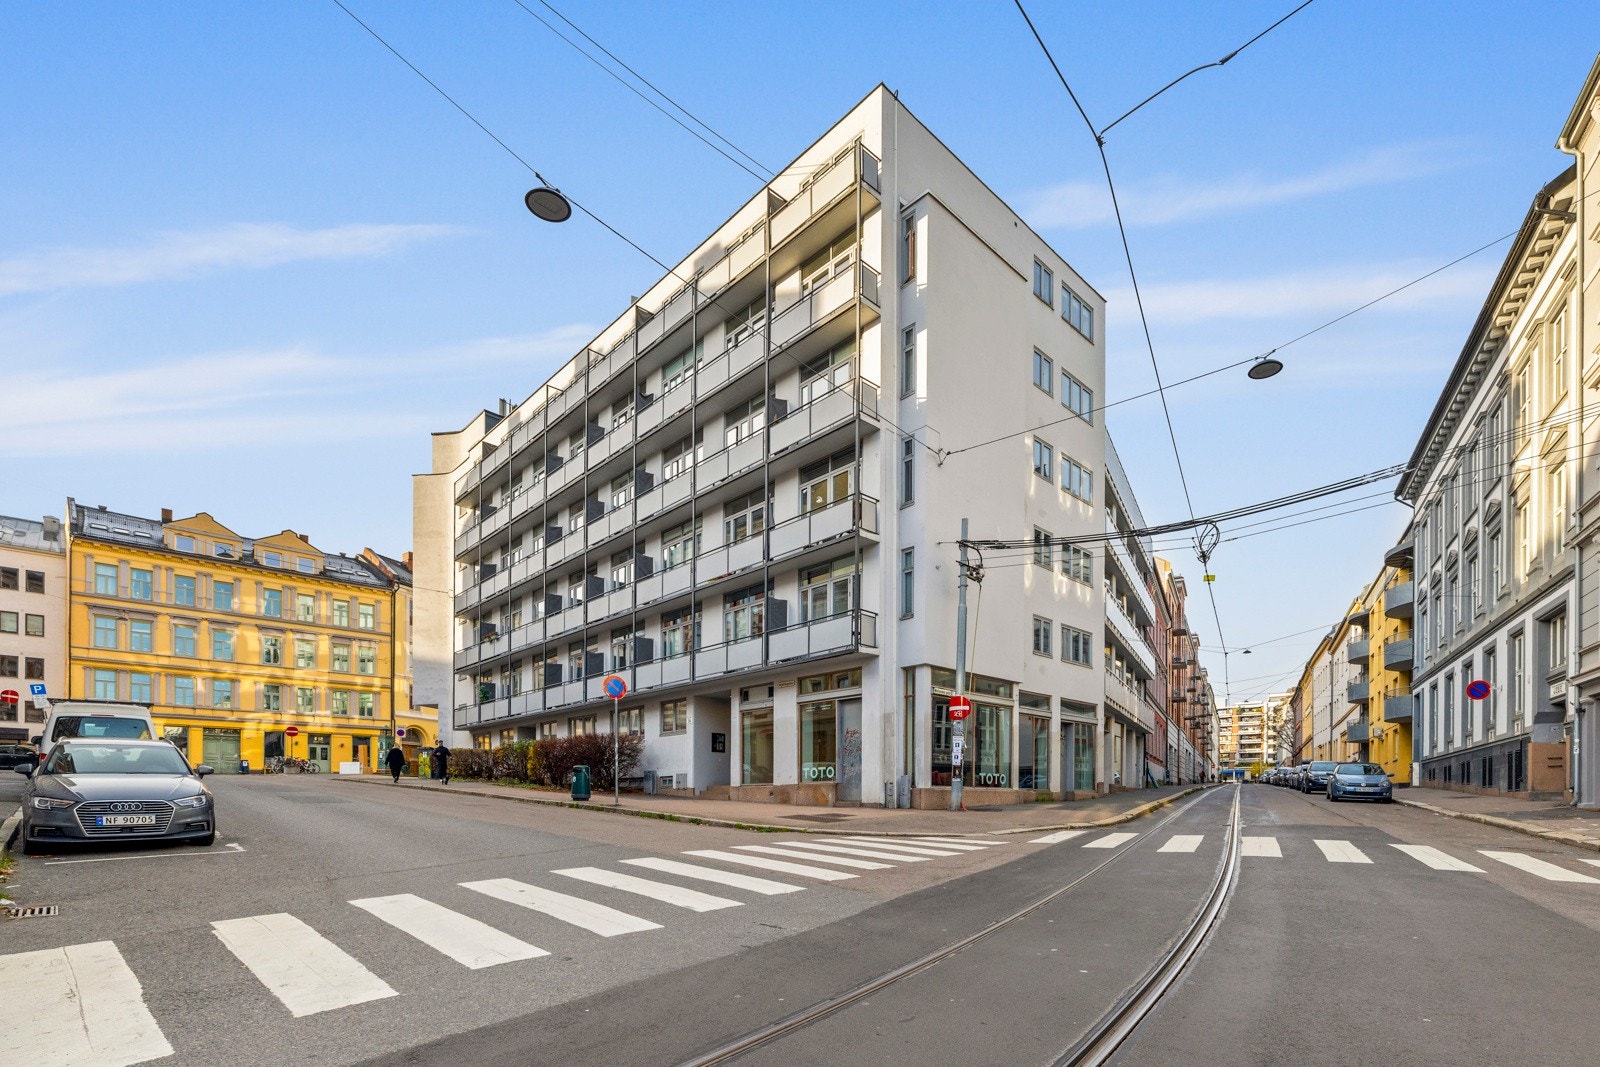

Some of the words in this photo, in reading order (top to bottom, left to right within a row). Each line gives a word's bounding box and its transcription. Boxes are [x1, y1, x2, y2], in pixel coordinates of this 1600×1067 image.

[33, 685, 42, 694] P
[803, 766, 835, 779] TOTO
[979, 773, 1007, 785] TOTO
[105, 816, 119, 825] NF
[122, 815, 153, 824] 90705
